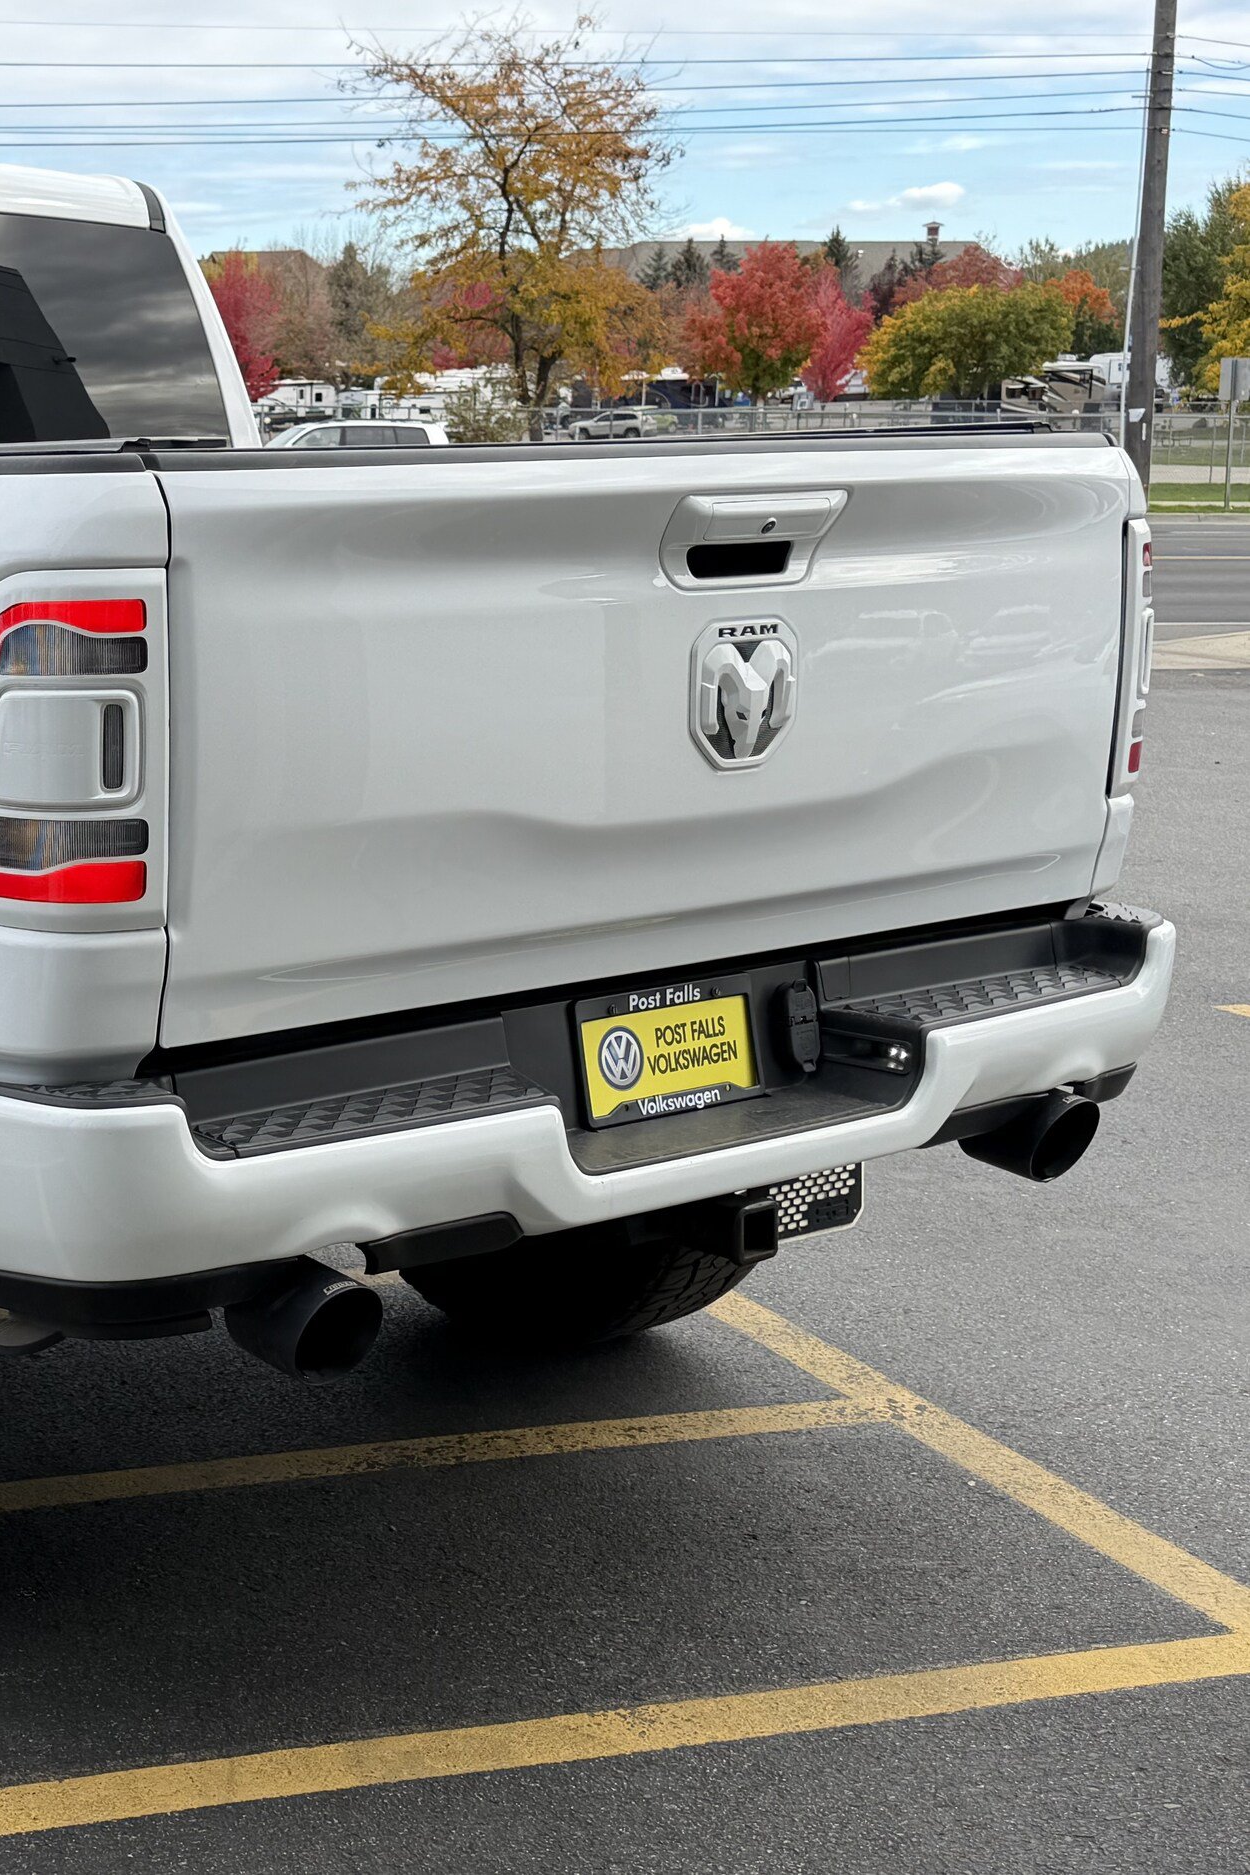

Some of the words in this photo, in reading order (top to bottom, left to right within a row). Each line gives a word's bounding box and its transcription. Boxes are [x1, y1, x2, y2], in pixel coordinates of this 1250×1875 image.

[717, 623, 779, 638] RAM
[629, 991, 661, 1012] Post
[666, 984, 701, 1005] Falls
[654, 1022, 687, 1047] POST
[691, 1015, 726, 1041] FALLS
[647, 1040, 738, 1076] VOLKSWAGEN
[637, 1089, 721, 1115] Volkswagen
